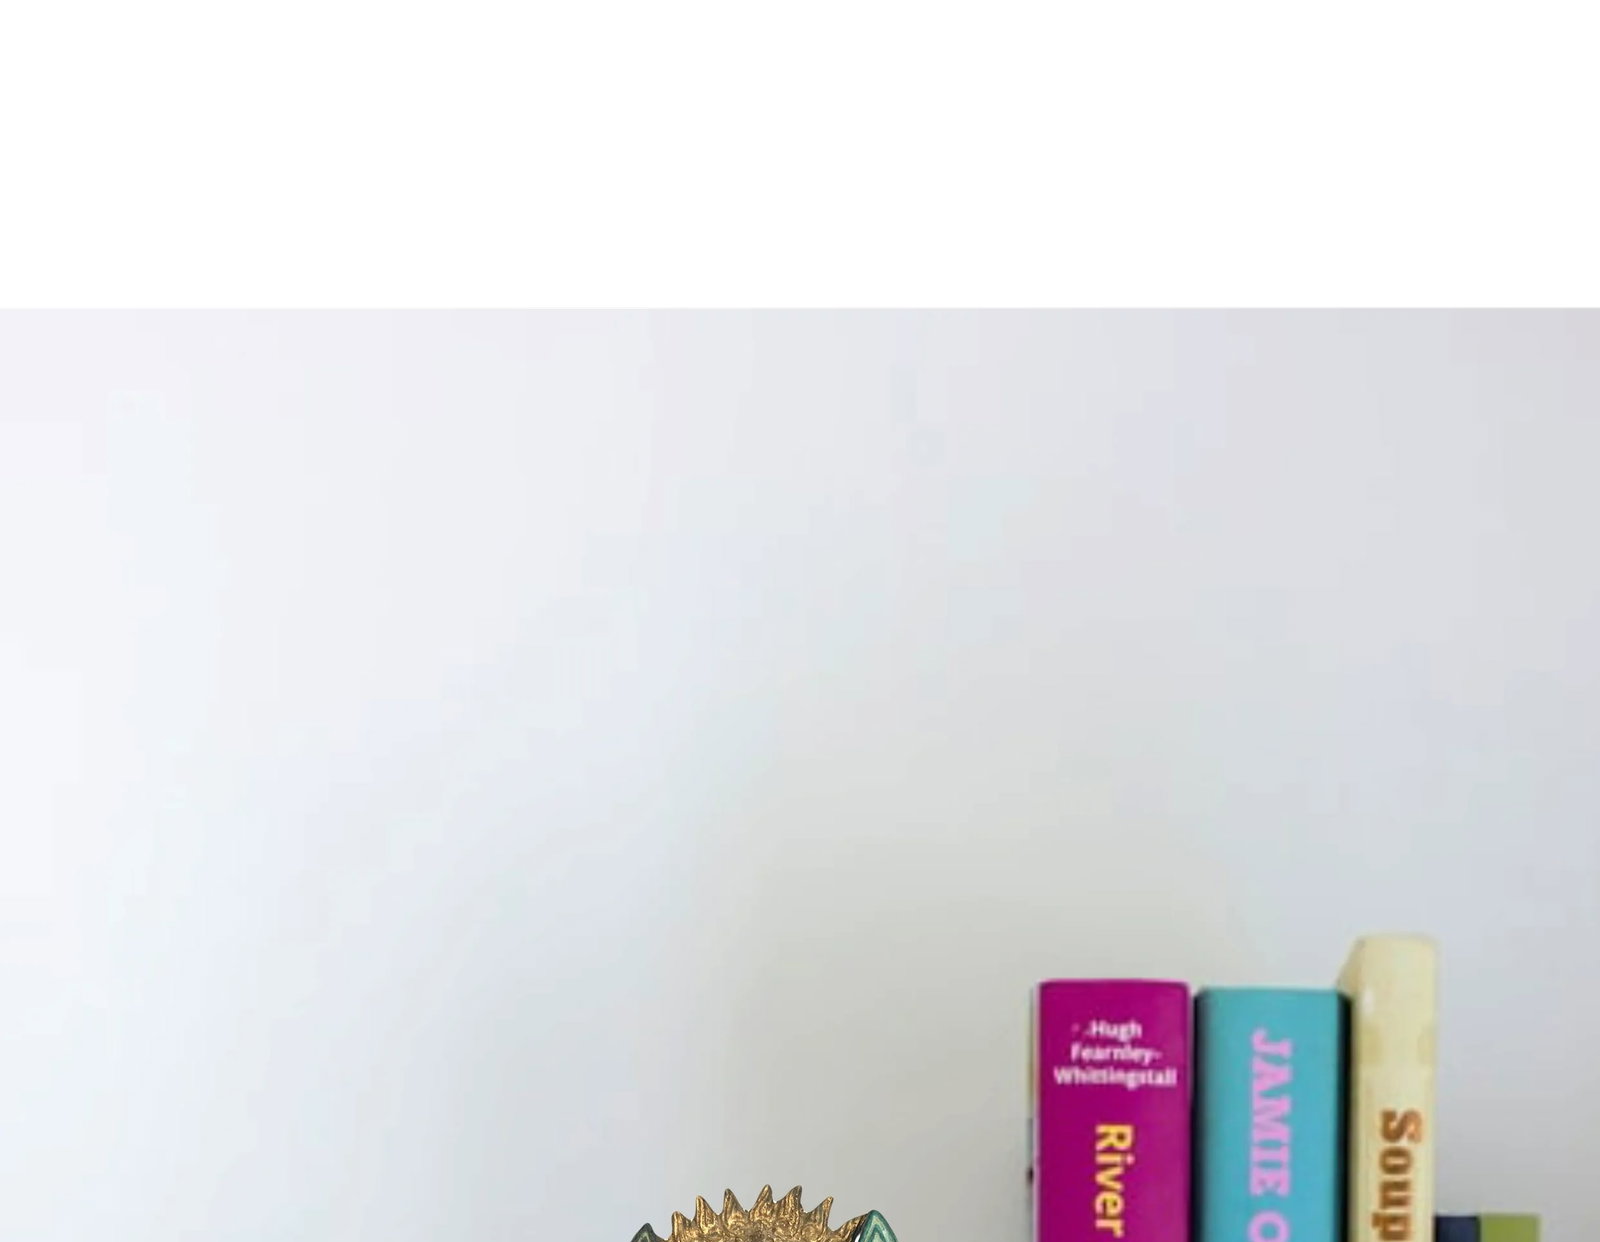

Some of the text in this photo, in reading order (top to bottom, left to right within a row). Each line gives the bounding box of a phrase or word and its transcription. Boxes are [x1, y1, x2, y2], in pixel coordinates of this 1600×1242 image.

[1249, 1028, 1292, 1196] JAMIE
[1372, 1110, 1422, 1242] Soup
[1095, 1124, 1136, 1237] River
